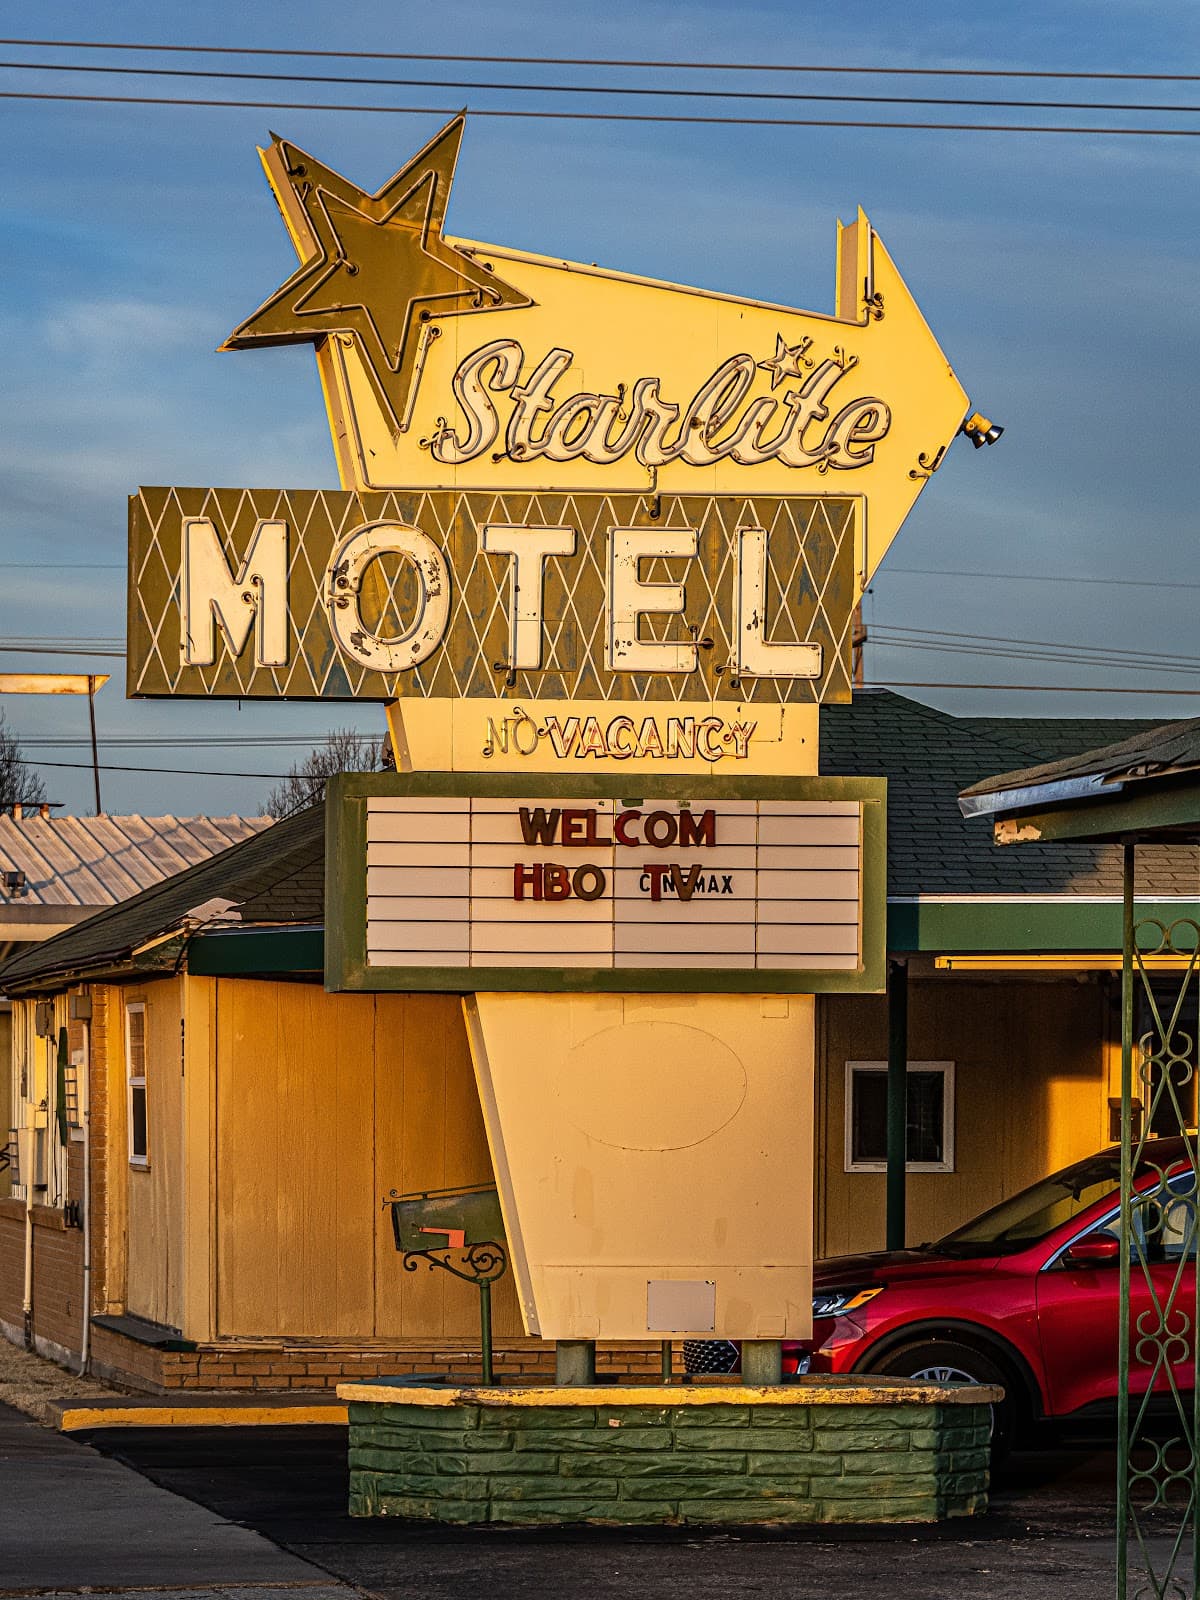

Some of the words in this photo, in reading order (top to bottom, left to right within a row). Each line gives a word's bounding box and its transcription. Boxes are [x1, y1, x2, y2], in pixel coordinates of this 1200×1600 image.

[431, 336, 892, 470] Starlite
[180, 516, 822, 679] MOTEL
[485, 715, 538, 757] NO
[545, 715, 758, 762] VACANCY
[518, 807, 716, 848] WELCOM
[513, 862, 607, 902] HBO
[643, 863, 703, 902] TV
[639, 873, 734, 894] CNMAX
